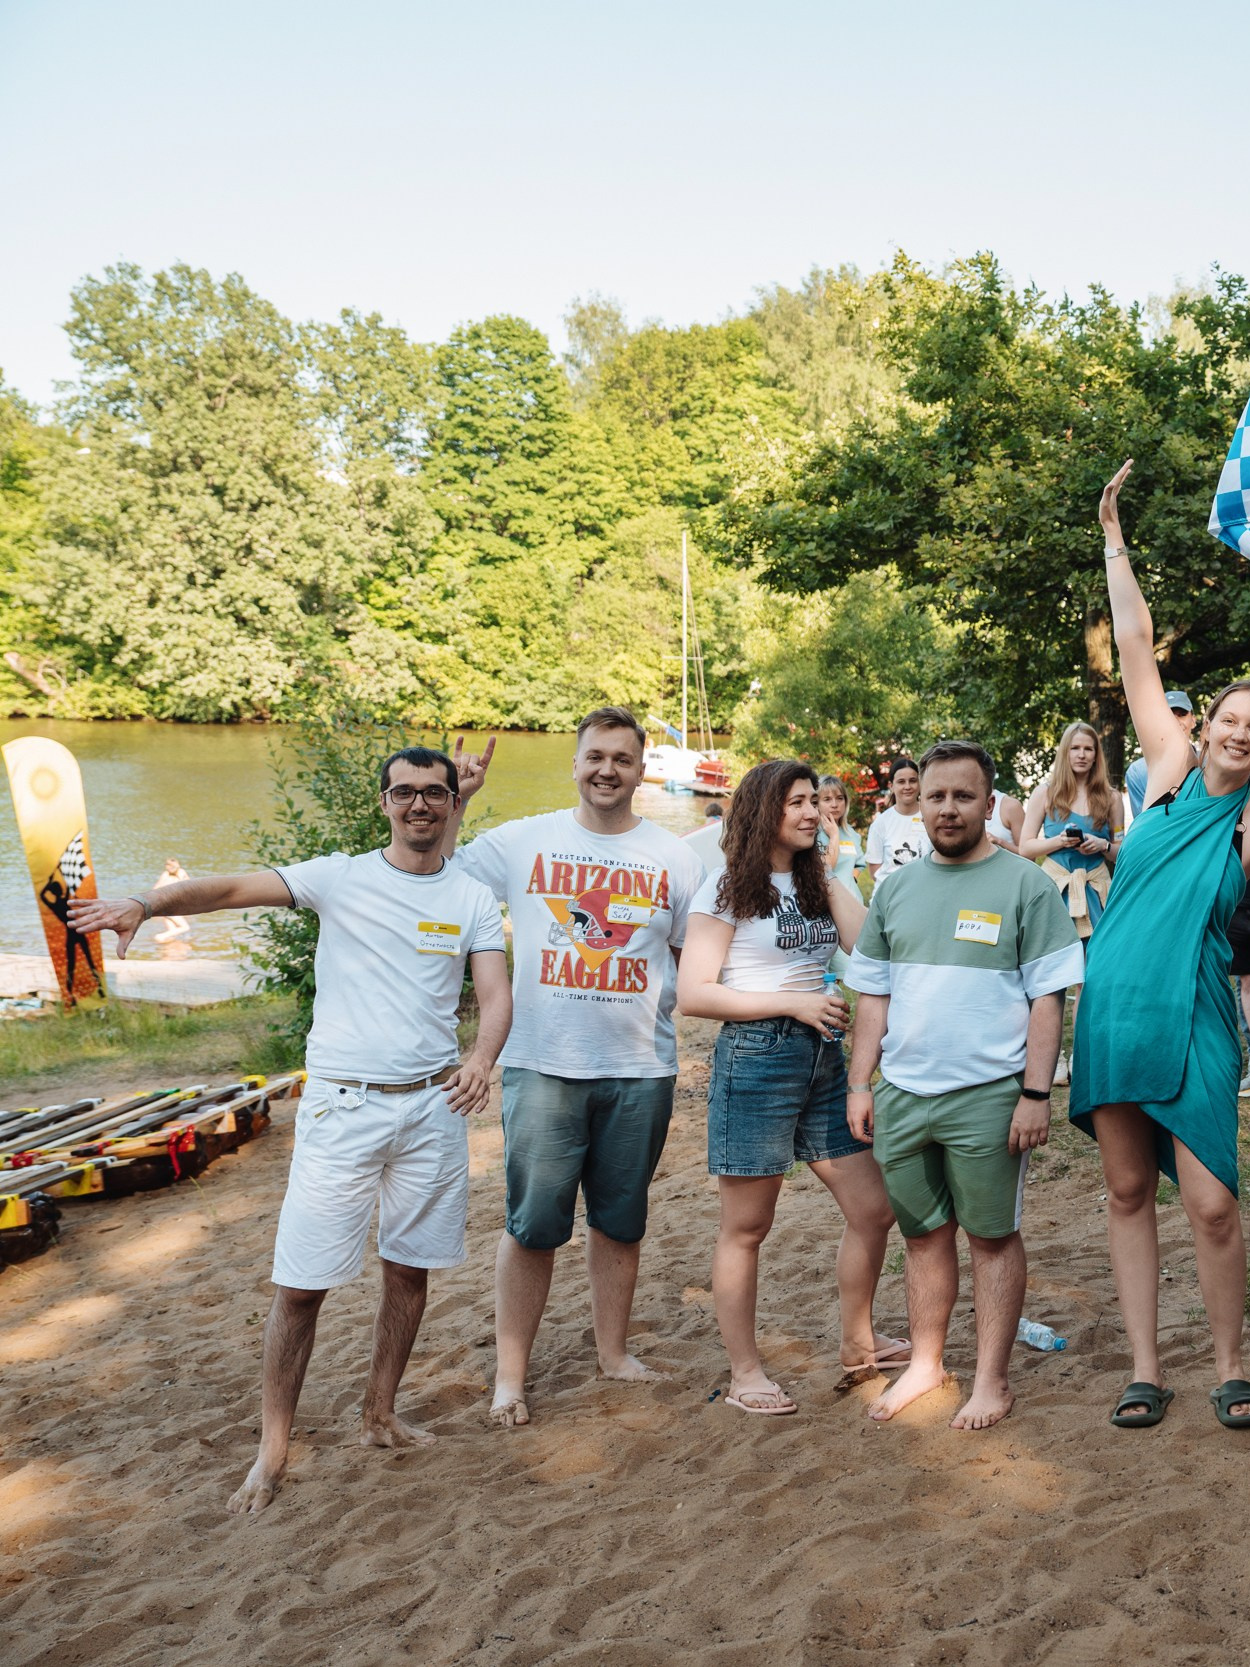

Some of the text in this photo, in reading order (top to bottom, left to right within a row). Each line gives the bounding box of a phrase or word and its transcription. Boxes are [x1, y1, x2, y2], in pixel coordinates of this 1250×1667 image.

[551, 852, 657, 872] WESTERN CONFERENCE
[526, 852, 672, 910] ARIZONA
[539, 949, 649, 994] EAGLES
[552, 992, 634, 1004] ALL-TIME CHAMPIONS
